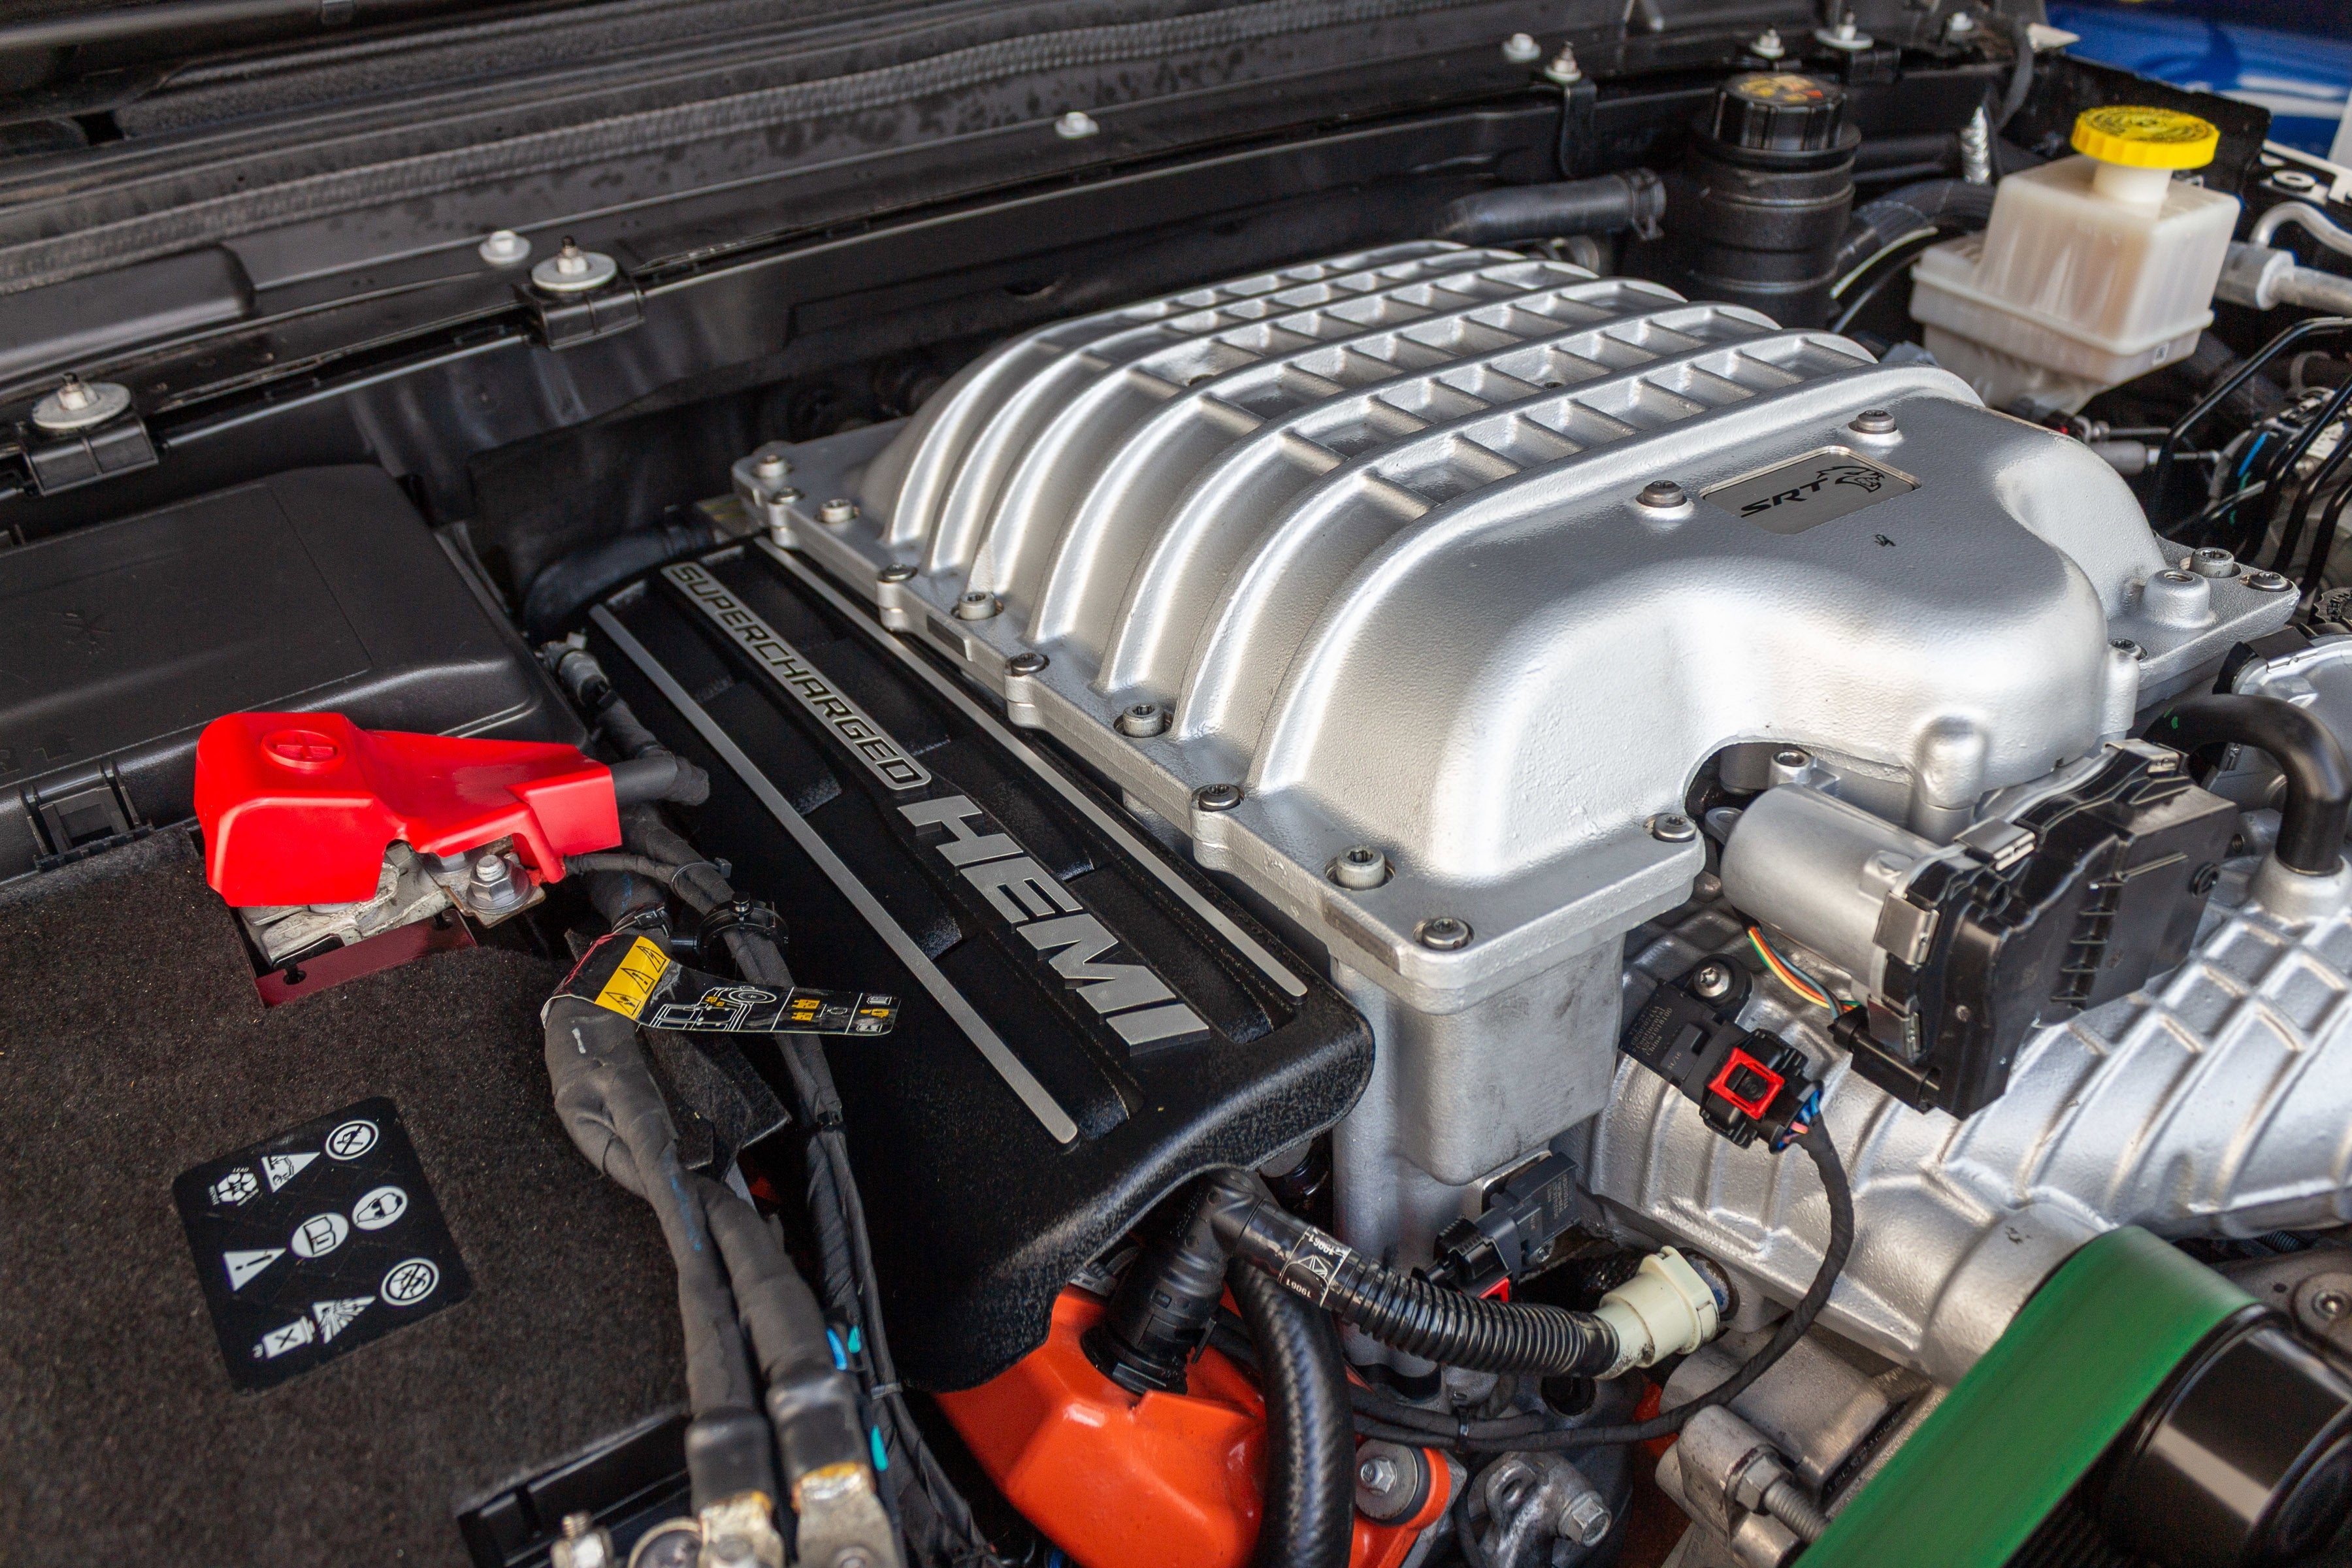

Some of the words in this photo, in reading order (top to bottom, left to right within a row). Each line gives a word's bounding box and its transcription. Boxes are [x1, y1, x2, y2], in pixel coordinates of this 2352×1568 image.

[1740, 478, 1828, 518] SRT
[670, 564, 924, 785] SUPERCHARGED
[897, 794, 1209, 1048] HEMI
[1285, 1278, 1312, 1299] 19061
